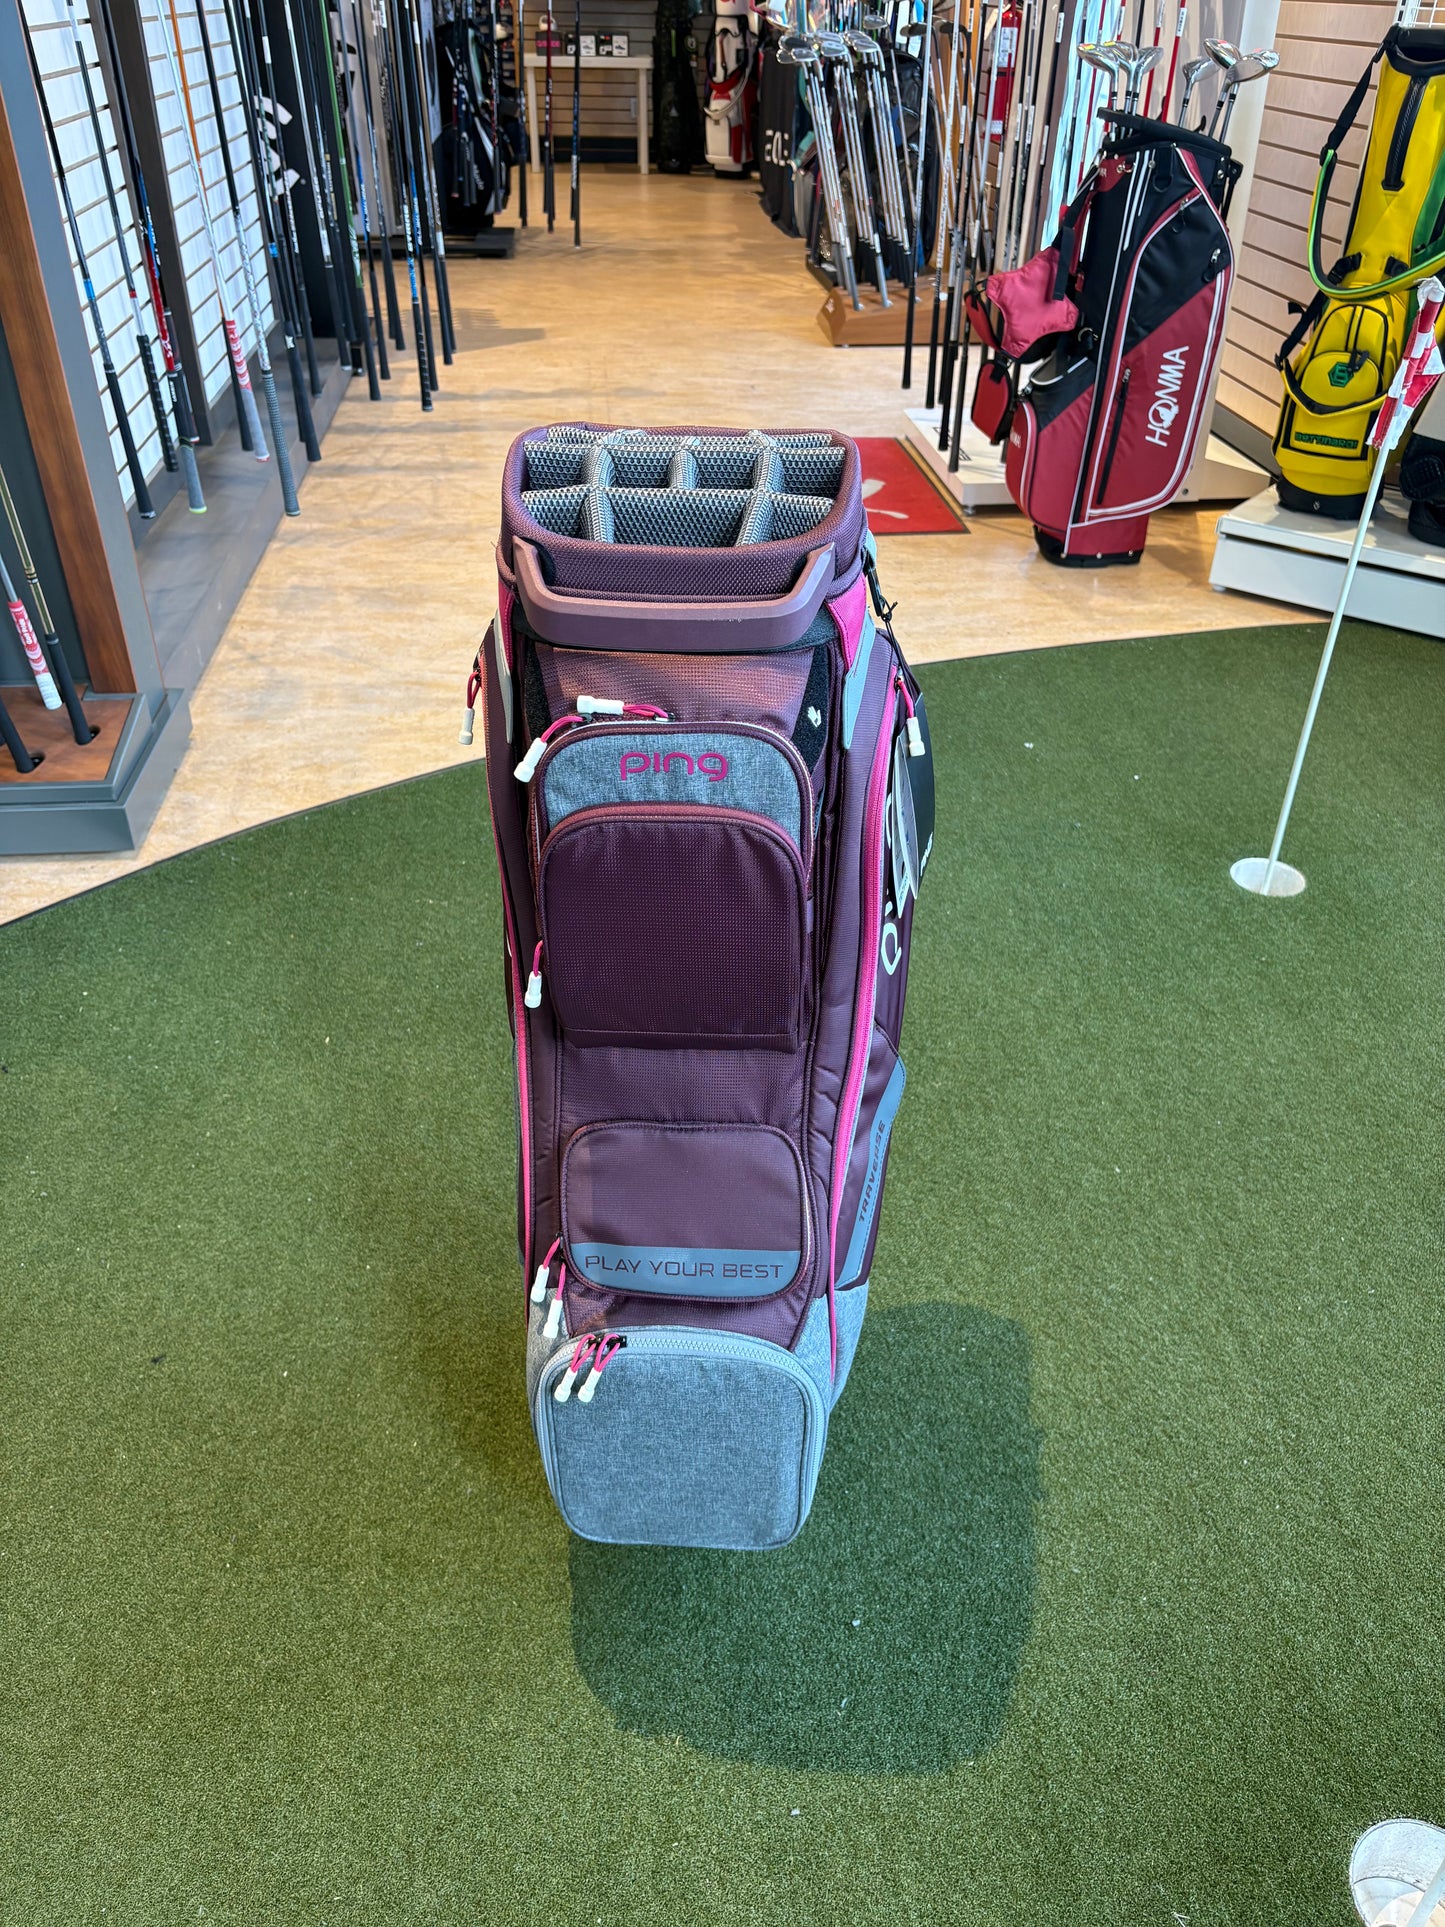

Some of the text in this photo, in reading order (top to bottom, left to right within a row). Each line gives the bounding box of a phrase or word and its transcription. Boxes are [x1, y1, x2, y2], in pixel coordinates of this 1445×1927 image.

[1145, 345, 1190, 447] HONMA
[858, 1119, 886, 1223] TRAVERSE
[584, 1255, 784, 1279] PLAY YOUR BEST
